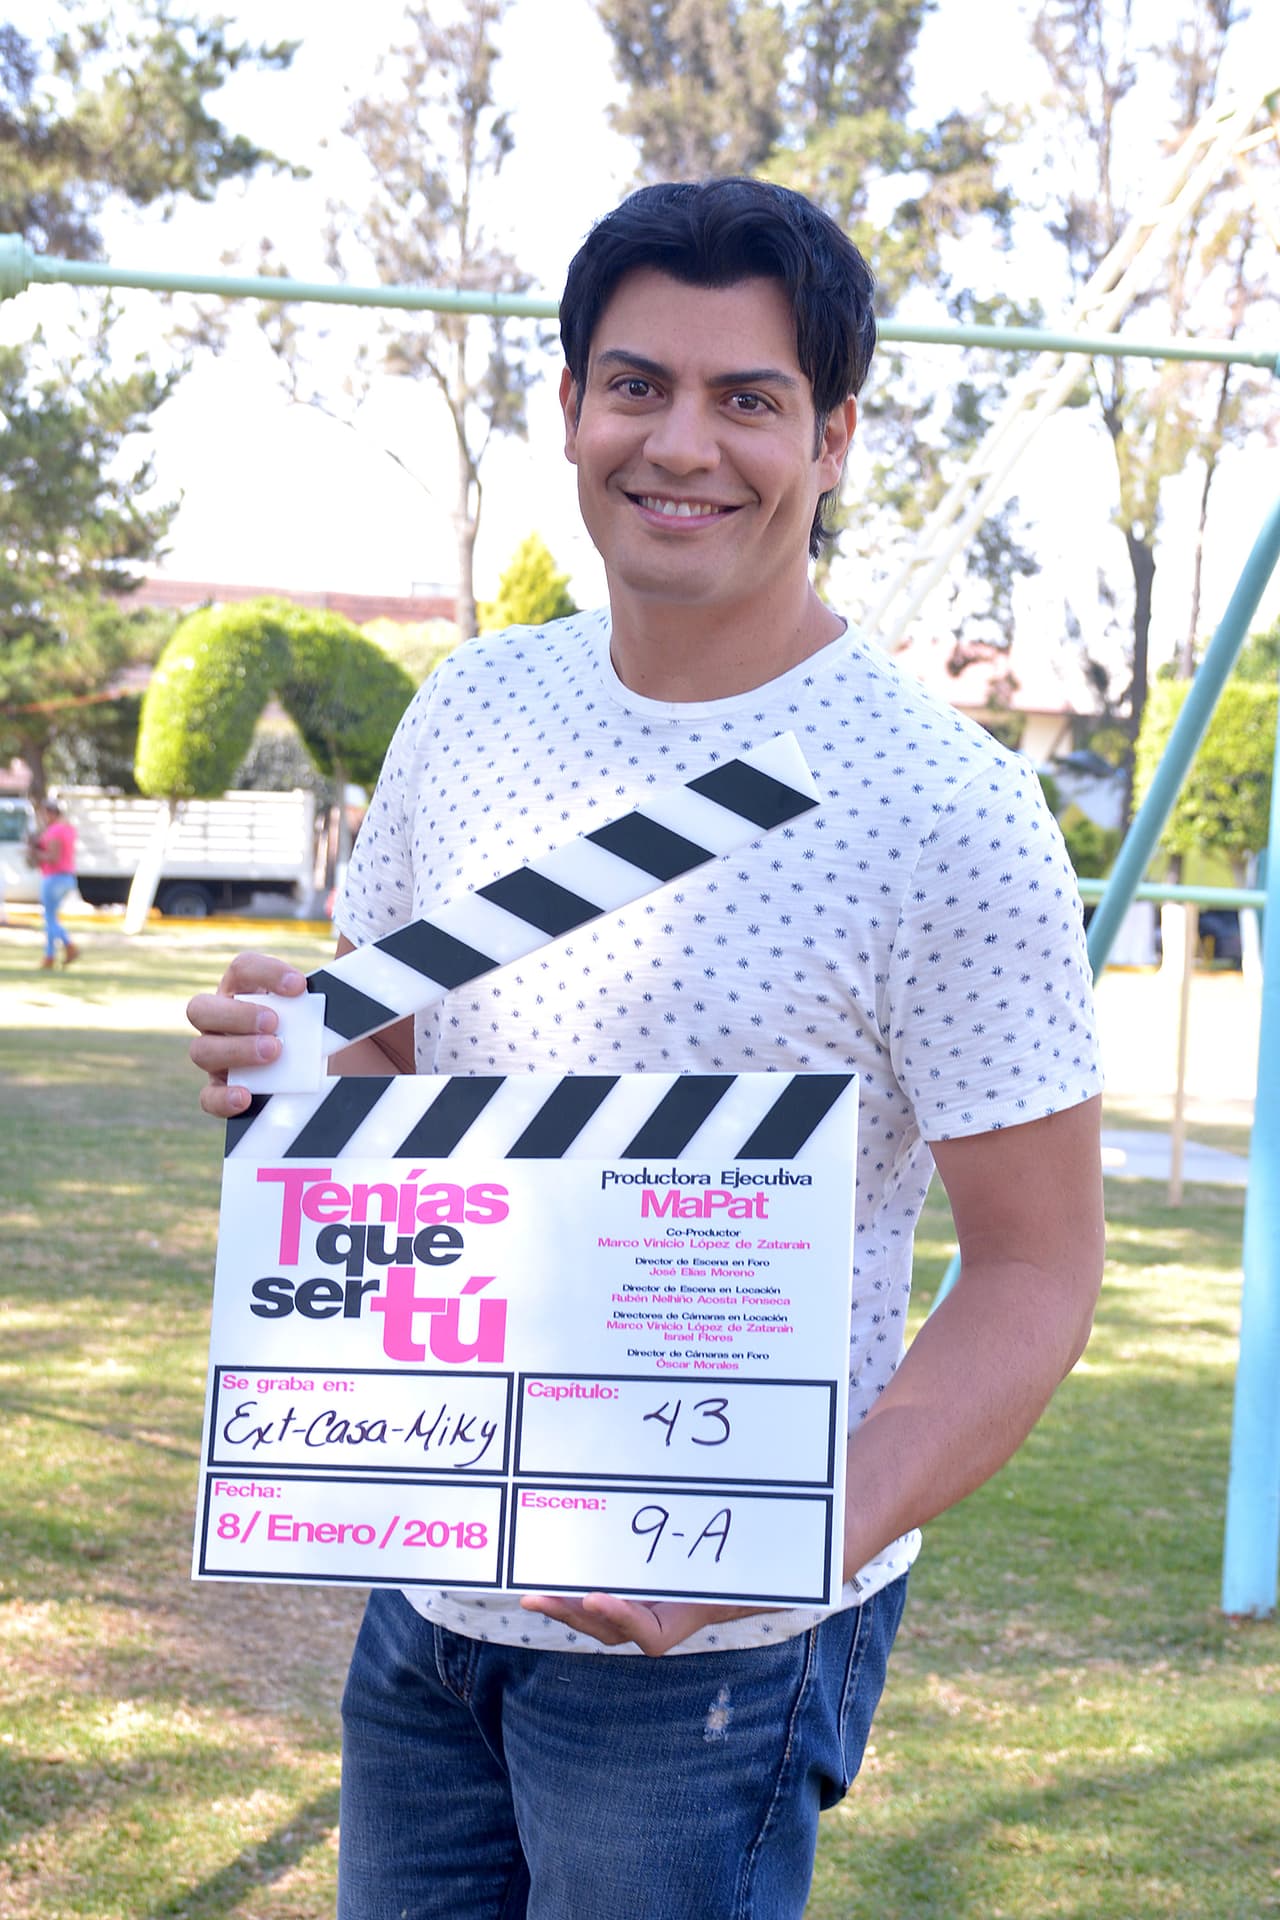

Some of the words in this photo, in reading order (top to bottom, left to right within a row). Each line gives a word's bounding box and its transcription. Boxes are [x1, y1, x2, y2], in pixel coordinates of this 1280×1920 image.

[601, 1167, 711, 1190] Productora
[721, 1167, 812, 1189] Ejecutiva
[641, 1189, 769, 1219] MaPat
[257, 1168, 509, 1266] Tenías
[666, 1228, 741, 1238] Co-Productor
[316, 1224, 464, 1277] que
[598, 1237, 639, 1248] Marco
[644, 1238, 685, 1249] Vinicio
[690, 1238, 730, 1251] López
[735, 1239, 752, 1249] de
[757, 1239, 811, 1250] Zatarain
[635, 1256, 673, 1266] Director
[677, 1257, 689, 1266] de
[693, 1258, 728, 1267] Escena
[732, 1259, 745, 1267] en
[748, 1258, 770, 1267] Foro
[649, 1267, 676, 1277] José
[711, 1268, 755, 1277] Moreno
[622, 1284, 660, 1293] Director
[664, 1285, 676, 1293] de
[680, 1285, 716, 1294] Escena
[736, 1286, 781, 1295] Locación
[250, 1277, 380, 1319] ser
[611, 1294, 648, 1304] Rubén
[697, 1295, 737, 1305] Acosta
[742, 1295, 791, 1306] Fonseca
[370, 1267, 507, 1363] tú
[613, 1311, 663, 1320] Directores
[666, 1311, 679, 1320] de
[682, 1312, 726, 1321] Cámaras
[743, 1313, 788, 1322] Locación
[606, 1321, 643, 1330] Marco
[647, 1321, 683, 1331] Vinicio
[687, 1322, 723, 1333] López
[728, 1323, 742, 1332] de
[747, 1323, 794, 1333] Zatarain
[664, 1332, 694, 1341] Israel
[698, 1333, 733, 1342] Flores
[627, 1349, 665, 1357] Director
[669, 1349, 682, 1358] de
[685, 1350, 729, 1359] Cámaras
[747, 1352, 770, 1360] Foro
[656, 1358, 690, 1369] Óscar
[694, 1361, 739, 1370] Morales
[222, 1374, 248, 1391] Se
[257, 1376, 315, 1394] graba
[322, 1380, 355, 1393] en:
[527, 1381, 619, 1402] Capítulo:
[643, 1398, 730, 1447] 43
[214, 1481, 282, 1499] Fecha:
[521, 1492, 607, 1511] Escena:
